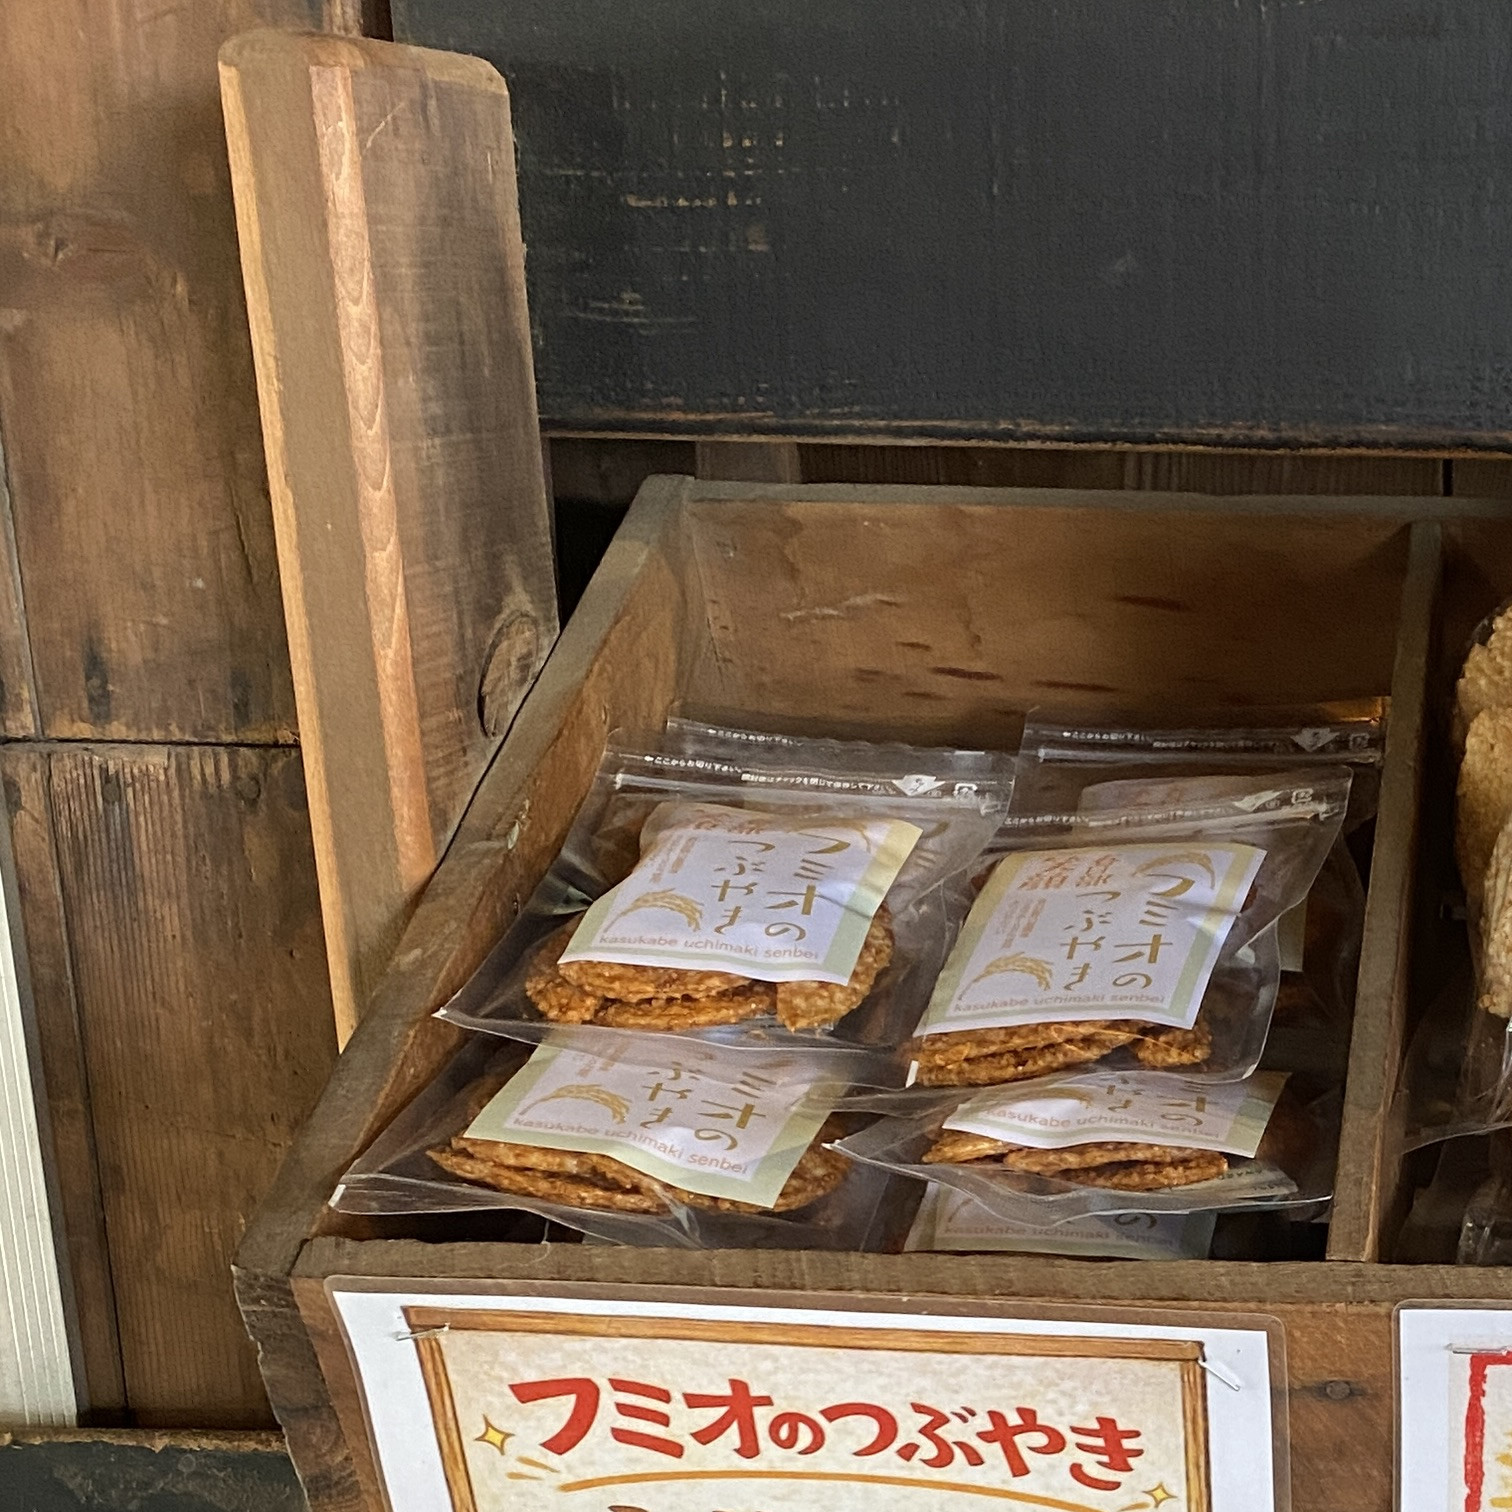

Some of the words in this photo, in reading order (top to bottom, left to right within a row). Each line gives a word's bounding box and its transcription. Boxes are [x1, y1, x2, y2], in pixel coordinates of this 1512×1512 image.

[599, 934, 679, 948] kasukabe
[683, 938, 759, 958] uchimaki
[762, 946, 820, 961] senbei
[603, 1129, 684, 1159] uchimaki
[687, 1151, 749, 1175] senbei
[508, 1376, 1146, 1493] フミオのつぶやき
